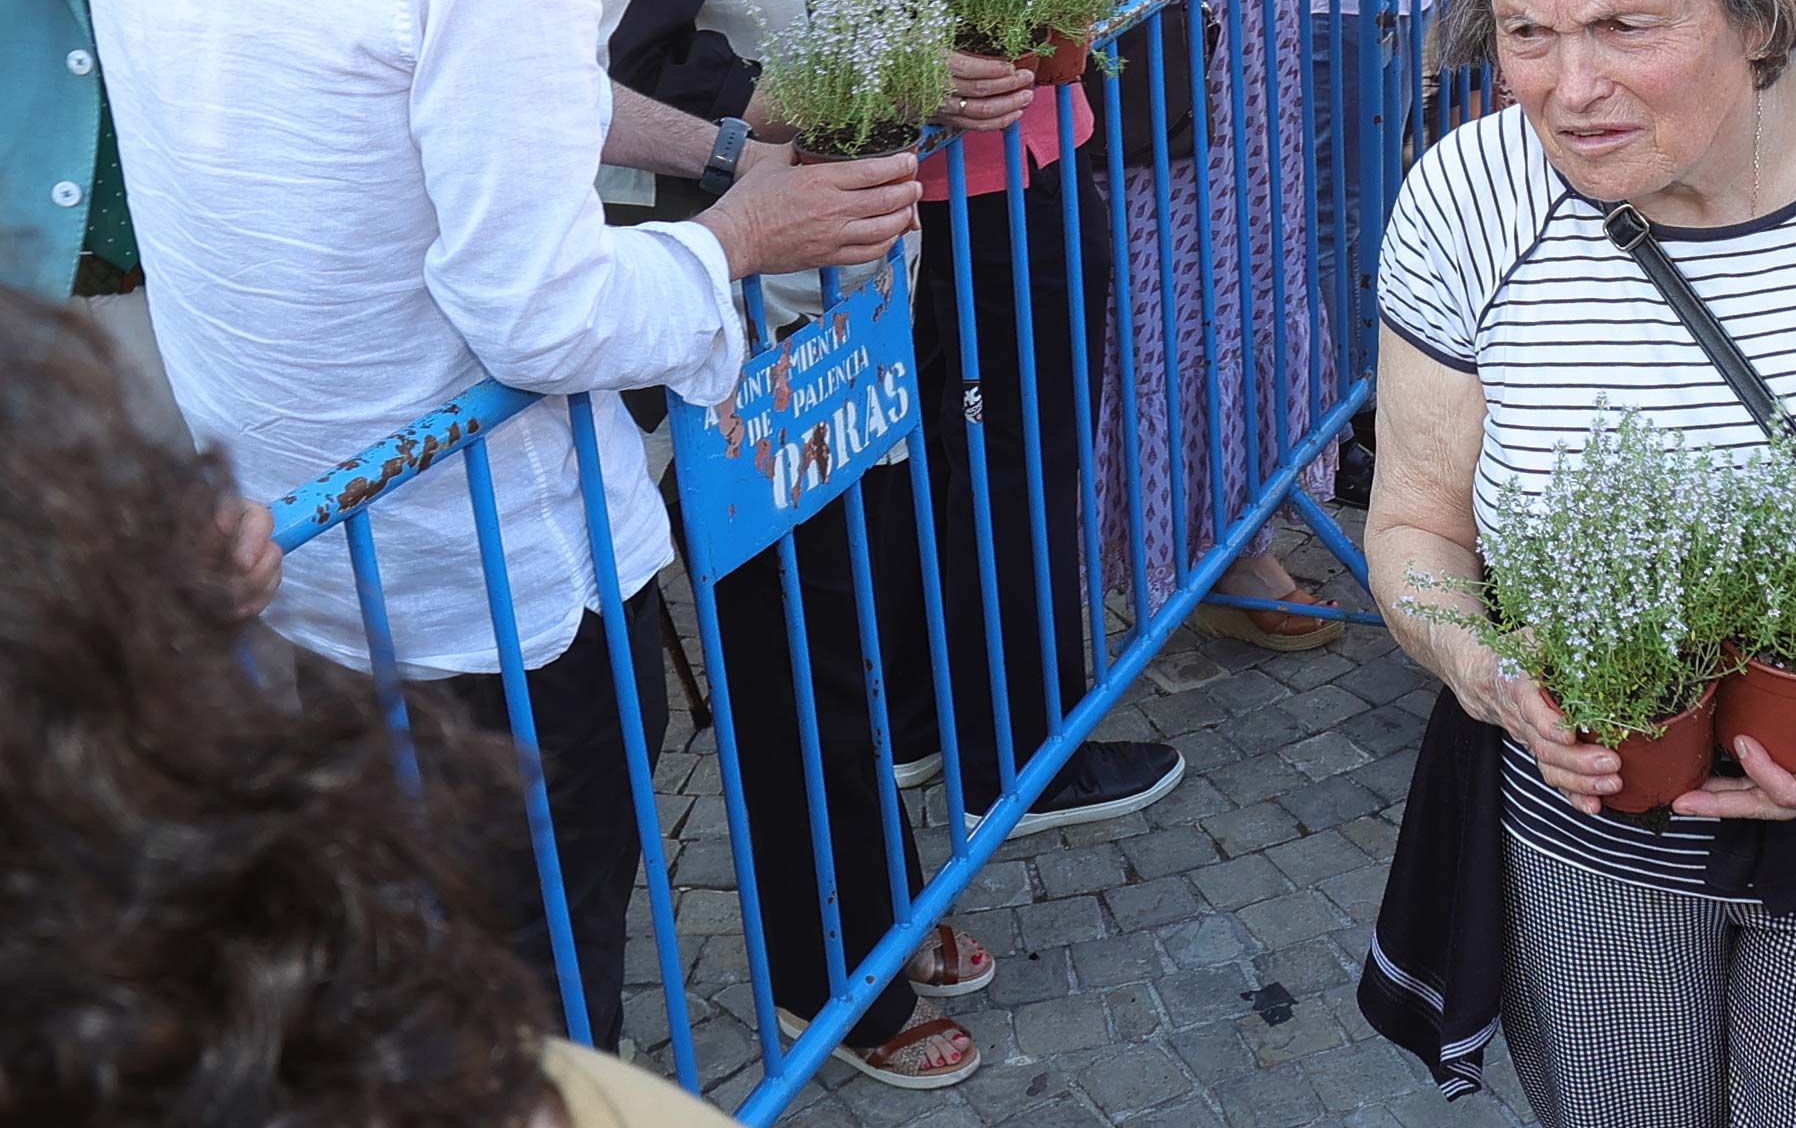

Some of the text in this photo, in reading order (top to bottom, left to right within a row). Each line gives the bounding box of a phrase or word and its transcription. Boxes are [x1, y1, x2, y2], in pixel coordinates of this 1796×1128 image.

[704, 315, 850, 430] AUNTMIENT
[748, 345, 870, 447] DE PALENCIA
